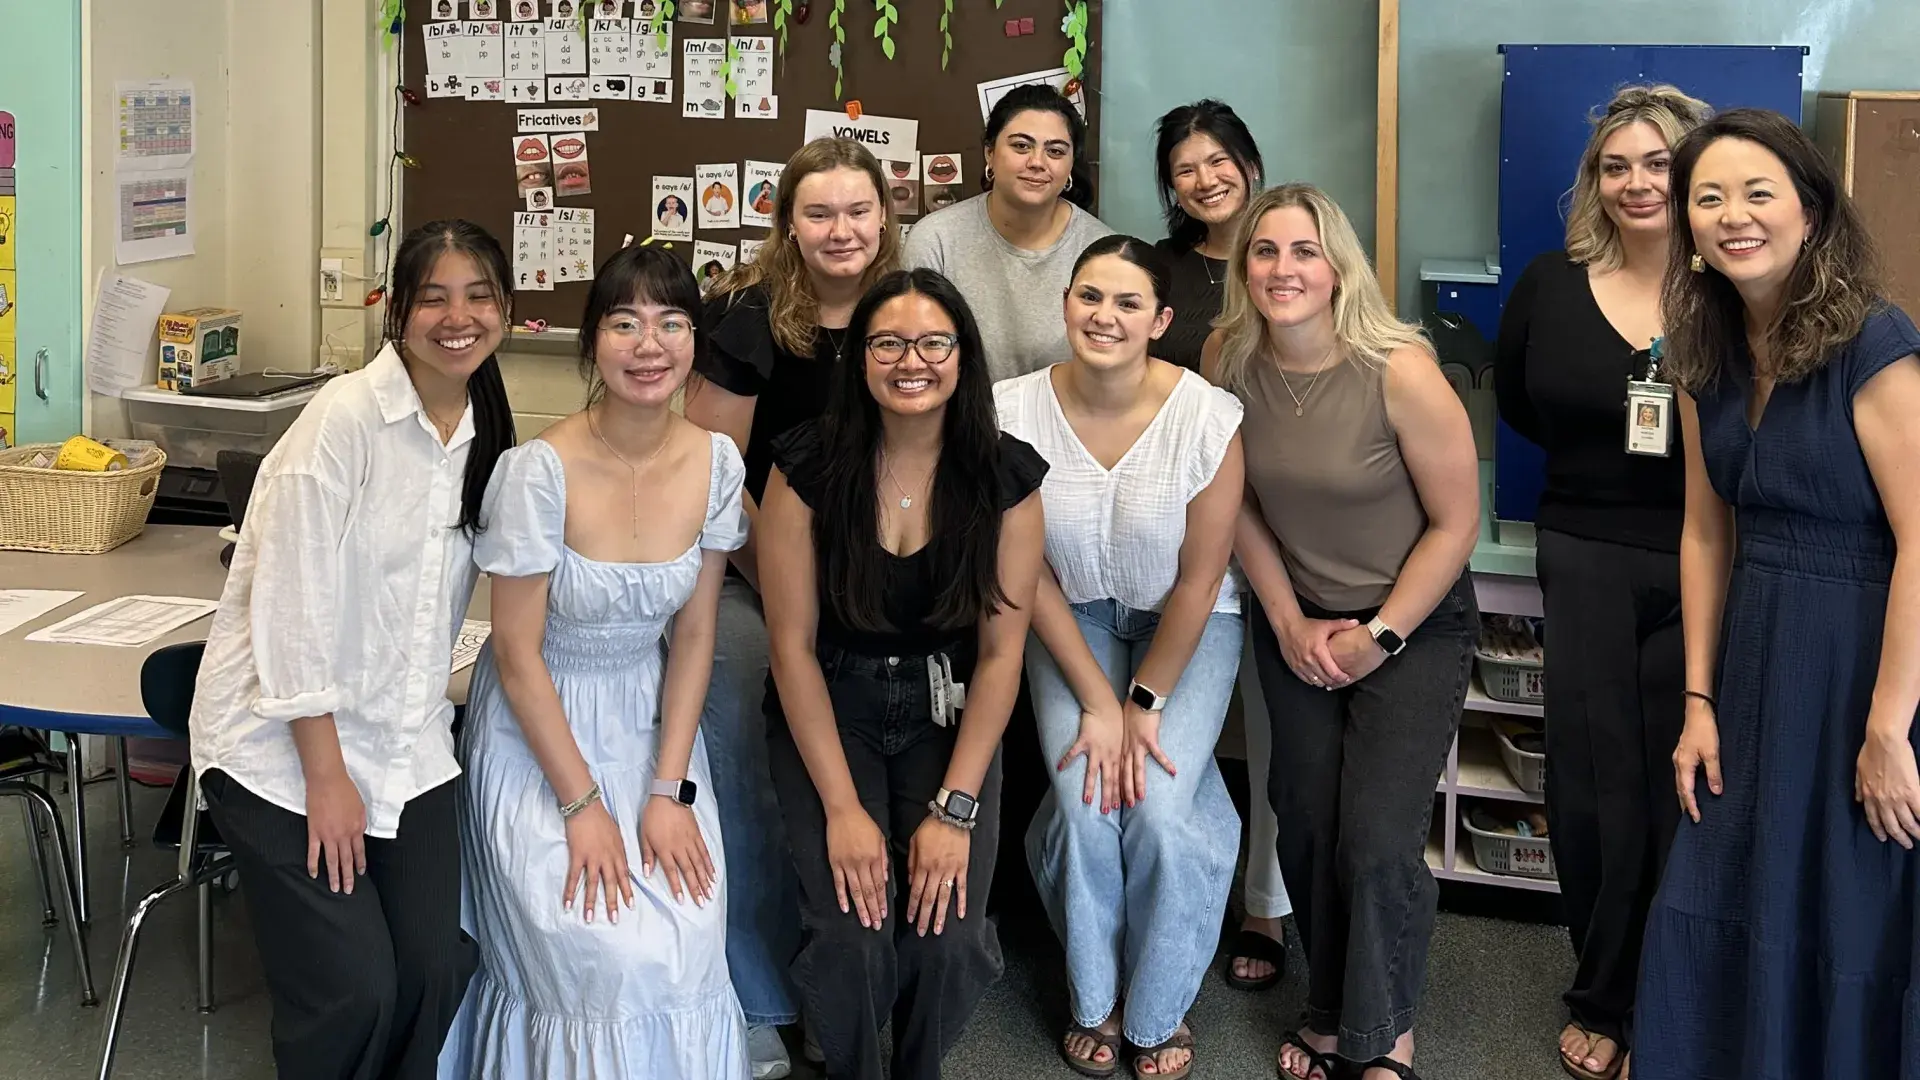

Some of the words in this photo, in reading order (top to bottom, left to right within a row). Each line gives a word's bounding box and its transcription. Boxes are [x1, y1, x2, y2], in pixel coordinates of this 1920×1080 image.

[429, 25, 444, 36] /b/
[468, 23, 484, 36] /p/
[510, 24, 524, 36] /t/
[549, 20, 565, 30] /d/
[594, 20, 610, 31] /k/
[563, 34, 568, 42] d
[481, 40, 486, 48] p
[686, 41, 706, 52] /m/
[736, 39, 753, 50] /n/
[442, 51, 451, 59] bb
[479, 51, 488, 59] pp
[431, 80, 439, 92] b
[472, 85, 479, 97] p
[512, 85, 518, 97] t
[554, 83, 562, 95] d
[593, 84, 600, 92] c
[638, 86, 646, 98] g
[686, 102, 698, 112] m
[743, 103, 750, 112] n
[519, 114, 582, 126] Fricatives
[833, 126, 890, 145] VOWELS
[519, 214, 535, 225] /f/
[559, 210, 574, 221] /s/
[703, 250, 720, 258] says
[561, 267, 567, 276] s
[520, 273, 527, 284] f
